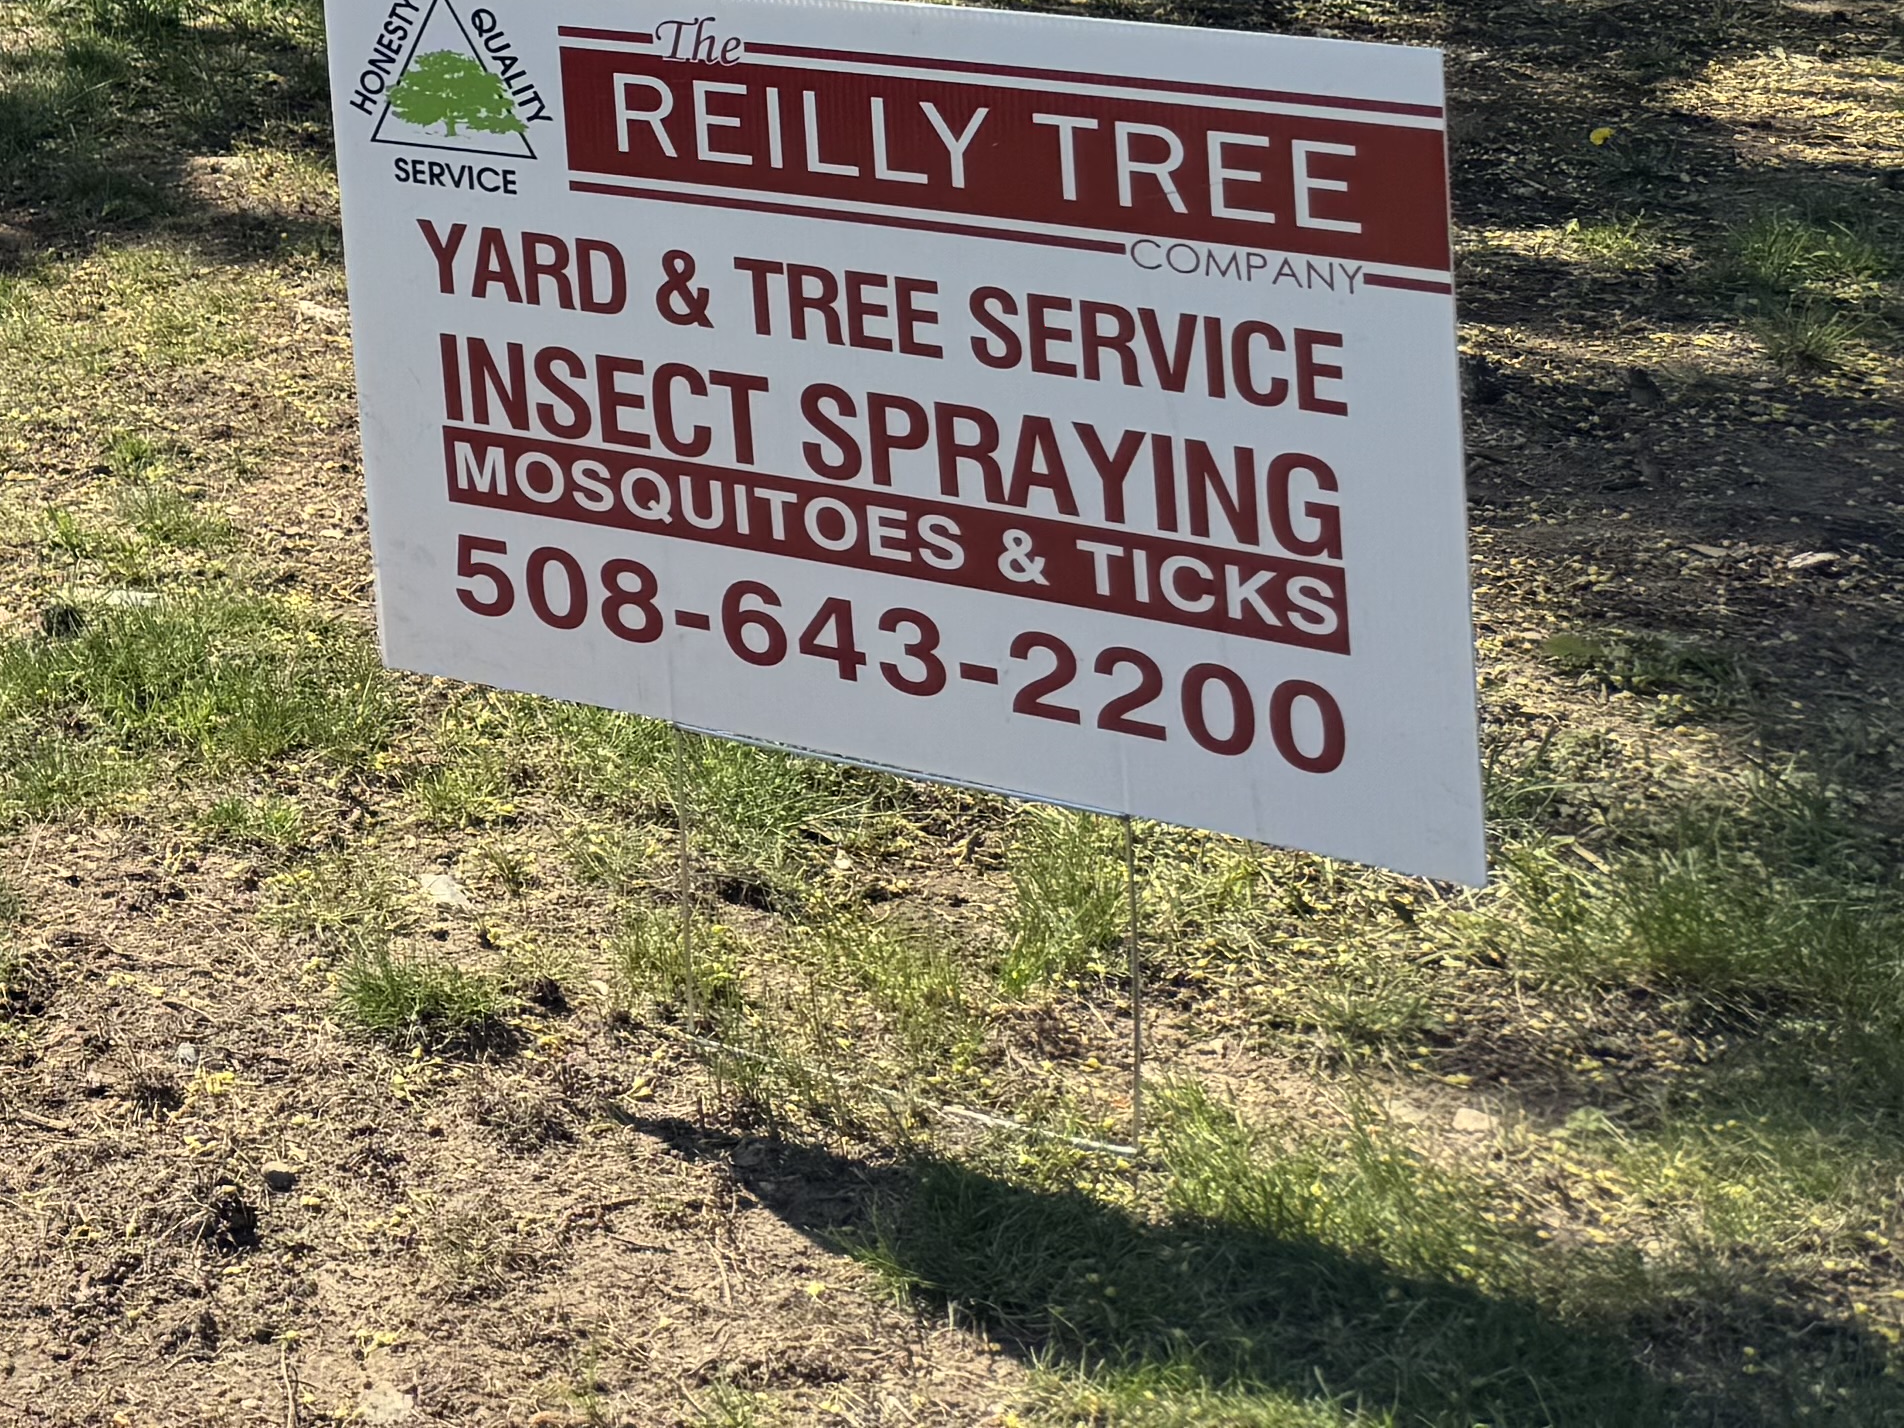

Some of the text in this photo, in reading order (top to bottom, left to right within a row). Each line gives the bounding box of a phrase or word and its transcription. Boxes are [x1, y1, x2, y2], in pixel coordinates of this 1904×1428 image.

[469, 7, 554, 128] QUALITY
[653, 17, 744, 69] The
[394, 156, 518, 195] SERVICE
[612, 71, 1364, 236] REILLY TREE
[417, 219, 1350, 417] YARD & TREE SERVICE
[1130, 238, 1364, 296] COMPANY
[438, 333, 1344, 562] INSECT SPRAYING
[453, 440, 1339, 639] MOSQUITOES & TICKS
[455, 533, 1347, 776] 508-643-2200
